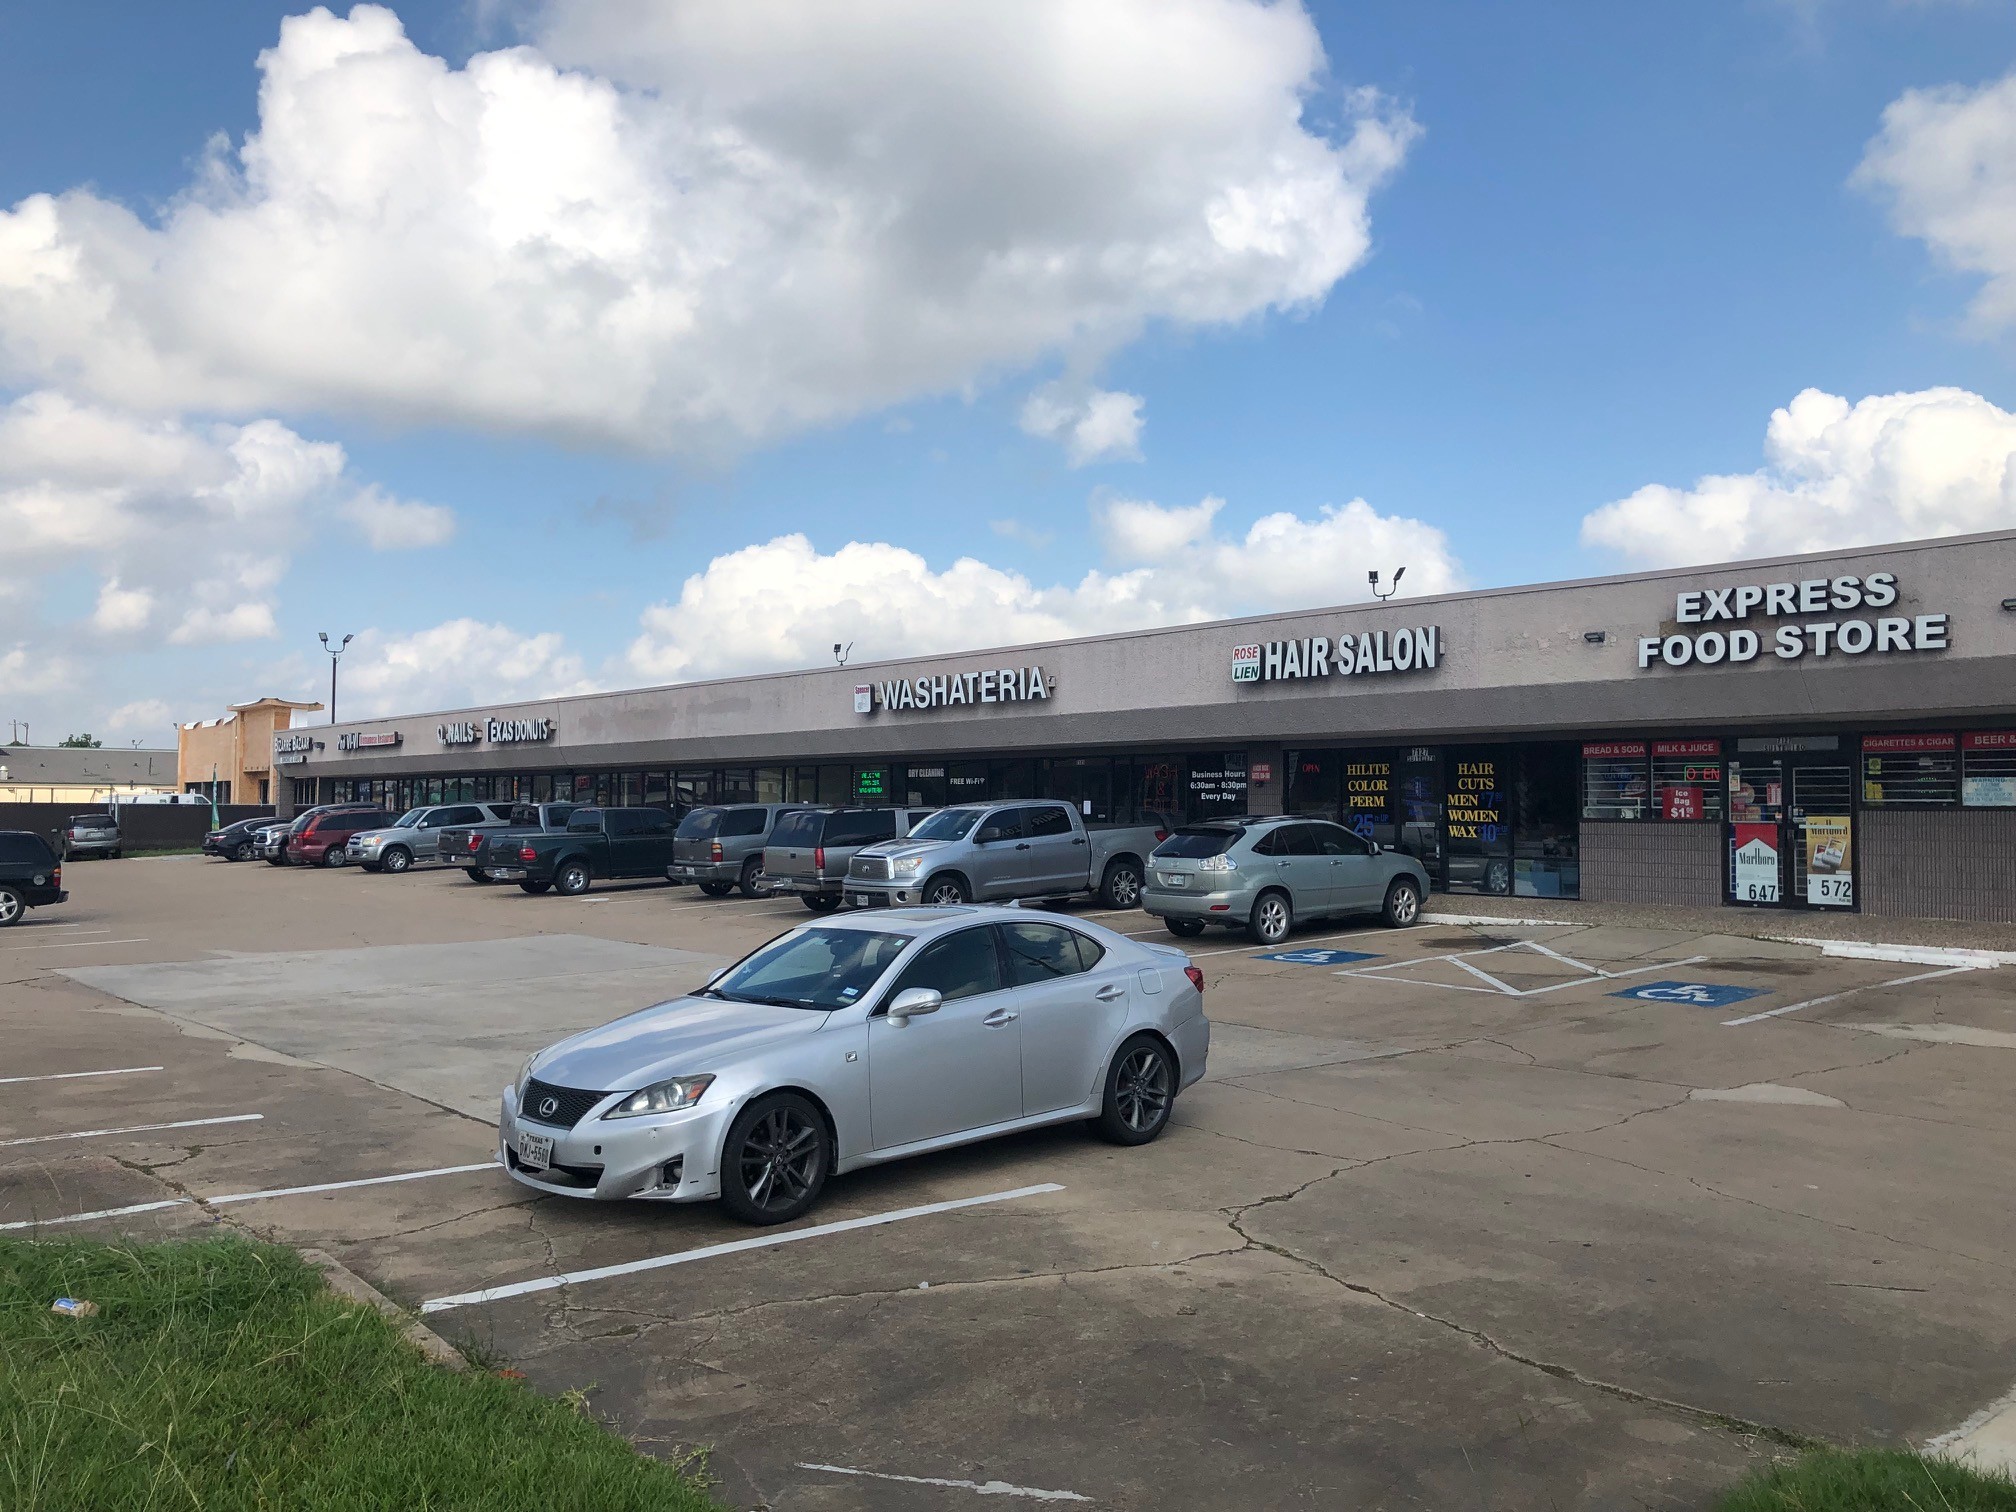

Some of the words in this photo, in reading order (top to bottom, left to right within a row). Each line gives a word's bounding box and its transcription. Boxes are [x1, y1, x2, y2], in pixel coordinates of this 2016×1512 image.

[1676, 573, 1897, 623] EXPRESS
[1638, 629, 1759, 668] FOOD
[1774, 613, 1948, 659] STORE
[1233, 646, 1258, 660] ROSE
[1265, 636, 1330, 680] HAIR
[1337, 625, 1436, 675] SALON
[1234, 665, 1259, 680] LIEN
[879, 666, 1047, 710] WASHATERIA
[447, 722, 474, 743] NAILS
[483, 718, 513, 742] TEXAS
[515, 718, 548, 741] DONUTS
[292, 736, 310, 751] BAZAAR
[1863, 738, 1916, 747] CIGARETTES
[1926, 738, 1954, 746] CIGAR
[1974, 735, 2006, 745] BEER
[1583, 746, 1612, 755] BREAD
[1621, 745, 1645, 753] SODA
[1657, 745, 1680, 753] MILK
[1688, 744, 1714, 752] JUICE
[920, 768, 945, 777] CLEANING
[1302, 763, 1320, 773] OPEN
[1346, 763, 1390, 775] HILITE
[1458, 763, 1494, 775] HAIR
[1191, 771, 1223, 779] Business
[1224, 770, 1246, 779] Hours
[1221, 781, 1247, 790] 8:30pm
[1348, 780, 1388, 791] COLOR
[1458, 778, 1495, 790] CUTS
[1201, 793, 1220, 802] Every
[1222, 792, 1236, 801] Day
[1349, 796, 1385, 807] PERM
[1447, 794, 1479, 806] MEN
[1673, 798, 1690, 806] Bag
[1448, 809, 1499, 822] WOMEN
[1448, 825, 1478, 838] WAX
[1739, 848, 1775, 866] Marlboro
